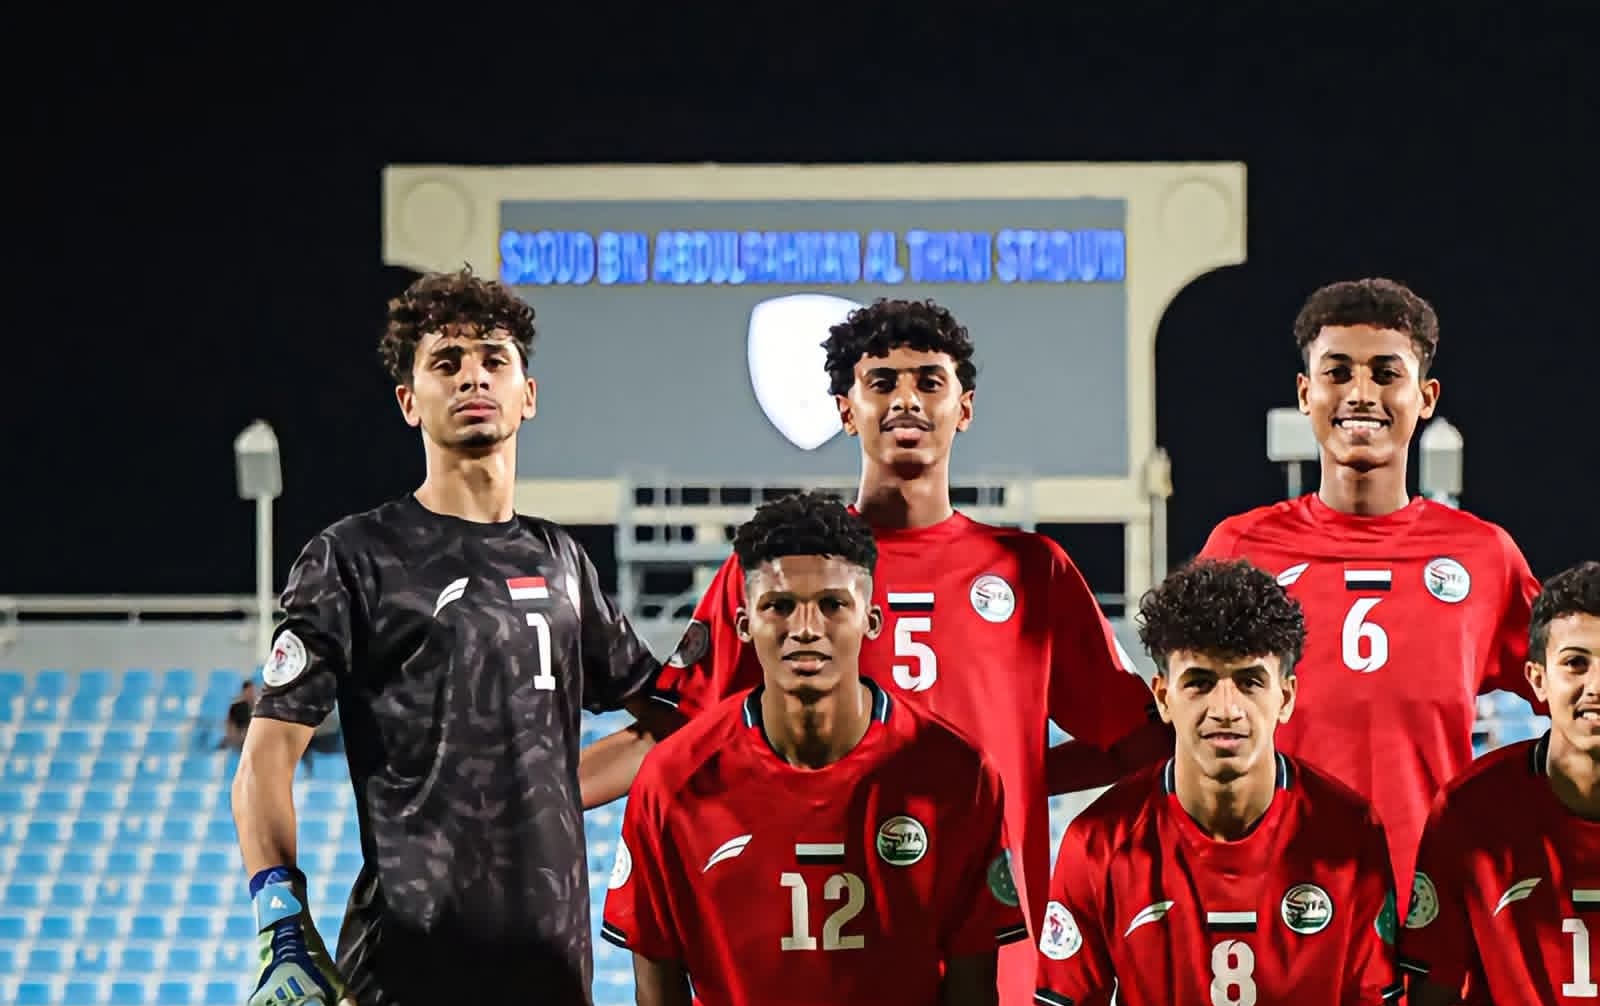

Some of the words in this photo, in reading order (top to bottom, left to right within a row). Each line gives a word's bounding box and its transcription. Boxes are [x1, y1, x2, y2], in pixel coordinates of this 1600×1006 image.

[526, 613, 555, 690] 1
[891, 617, 938, 692] 5
[1342, 598, 1388, 673] 6
[780, 872, 864, 950] 12
